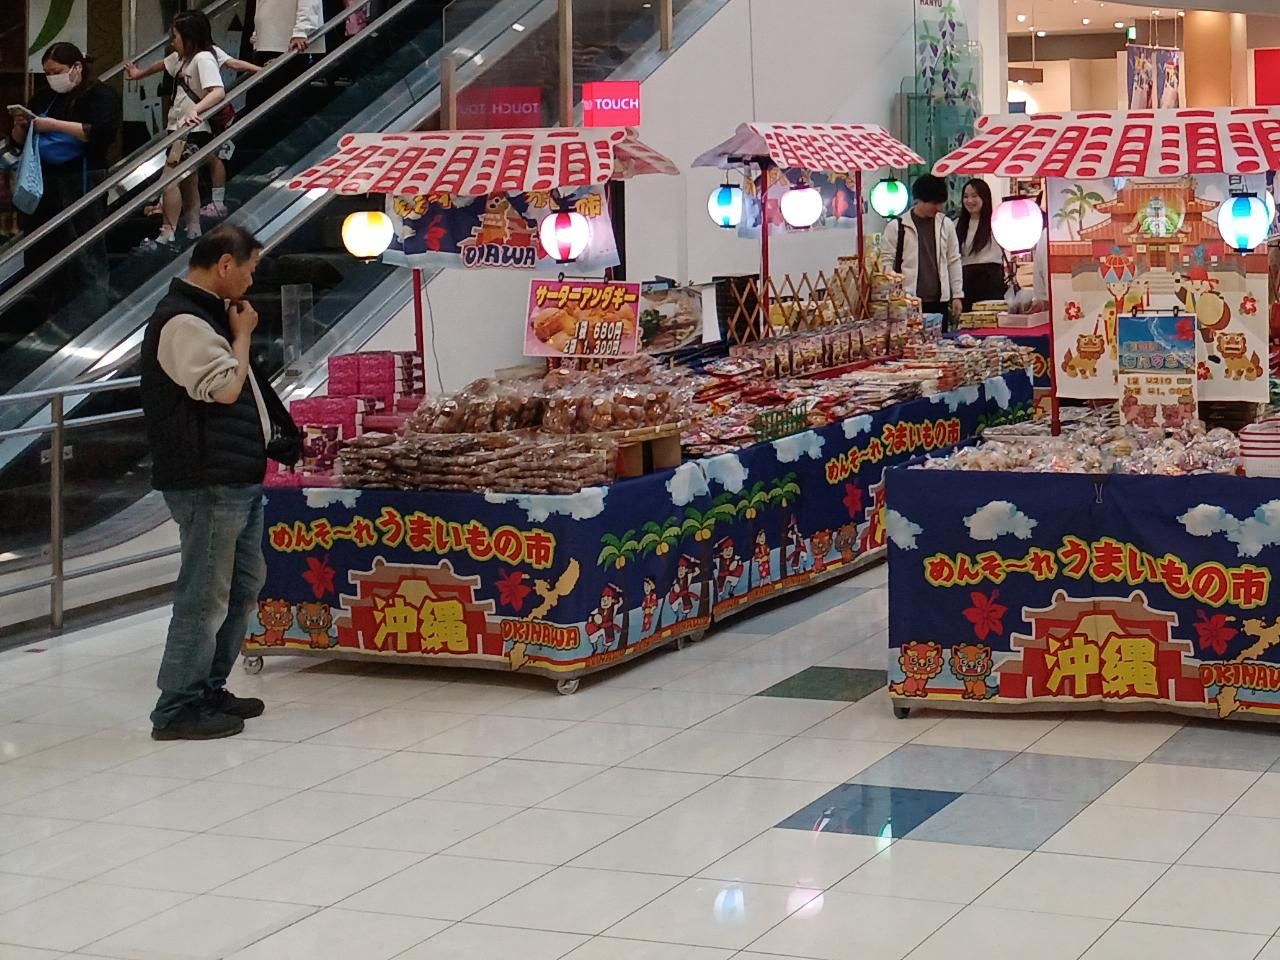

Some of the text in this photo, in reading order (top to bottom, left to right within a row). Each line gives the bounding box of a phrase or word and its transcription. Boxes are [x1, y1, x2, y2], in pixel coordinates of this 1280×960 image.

[595, 98, 639, 110] TOUCH
[535, 284, 638, 311] サーターアンダギー
[593, 321, 623, 340] 680円
[881, 417, 961, 456] うまいもの市
[378, 506, 556, 569] うまいもの市
[1056, 534, 1273, 610] うまいもの市
[373, 596, 470, 654] 沖縄
[501, 618, 581, 651] OKINAWA
[1044, 632, 1161, 699] 沖縄
